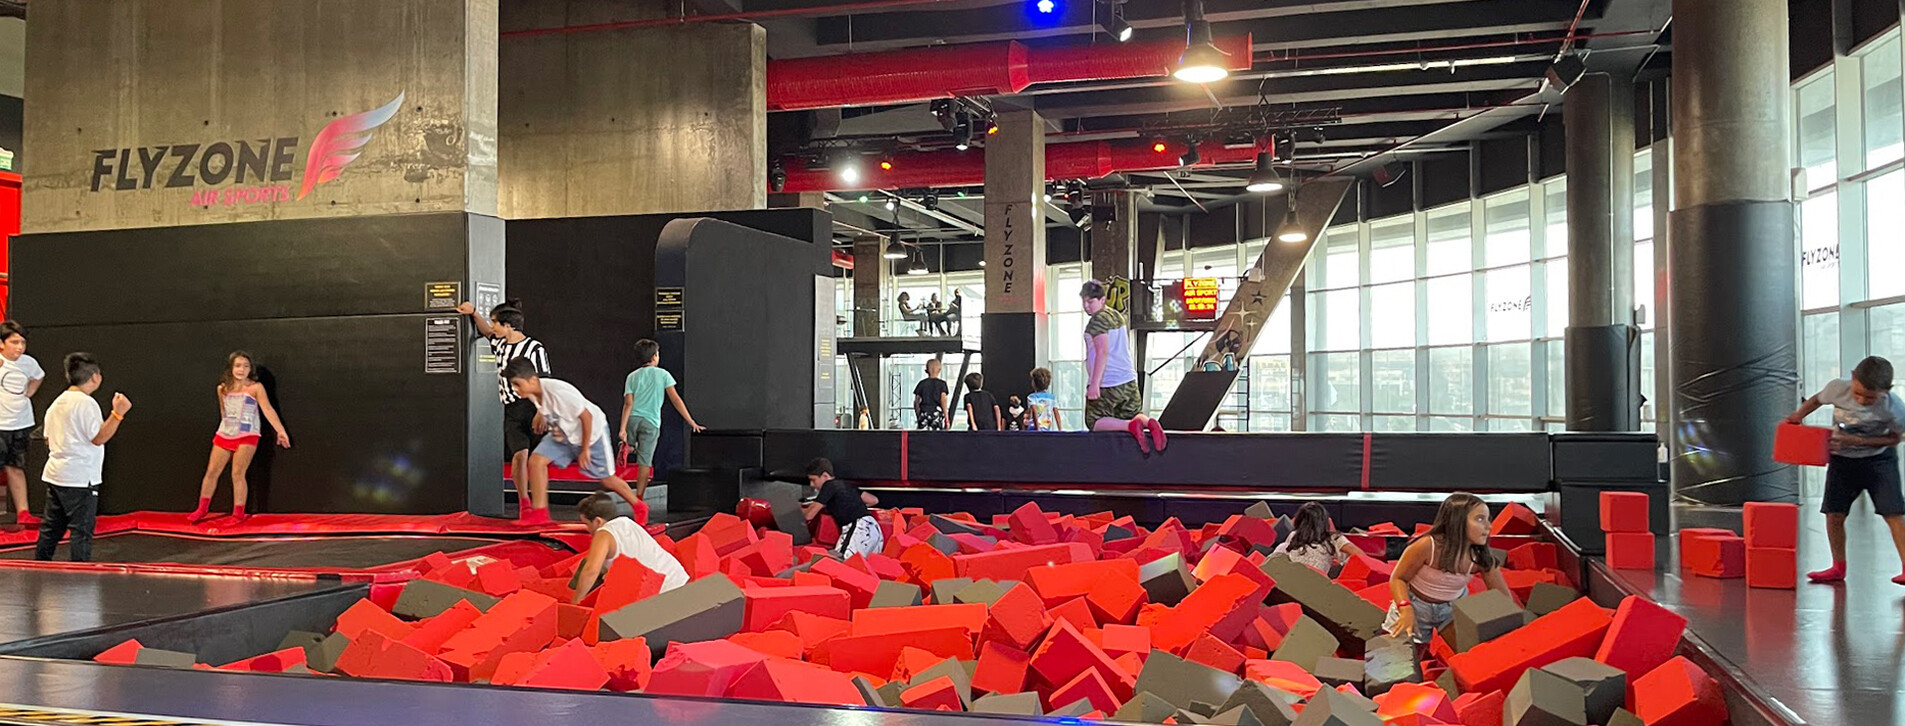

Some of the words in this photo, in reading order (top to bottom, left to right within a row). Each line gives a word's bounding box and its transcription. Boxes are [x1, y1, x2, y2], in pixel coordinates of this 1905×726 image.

[90, 137, 299, 192] FLYZONE
[189, 188, 218, 206] AIR
[224, 185, 291, 205] SPORTS
[1003, 204, 1014, 293] FLYZONE
[1490, 299, 1522, 312] FLYZONE
